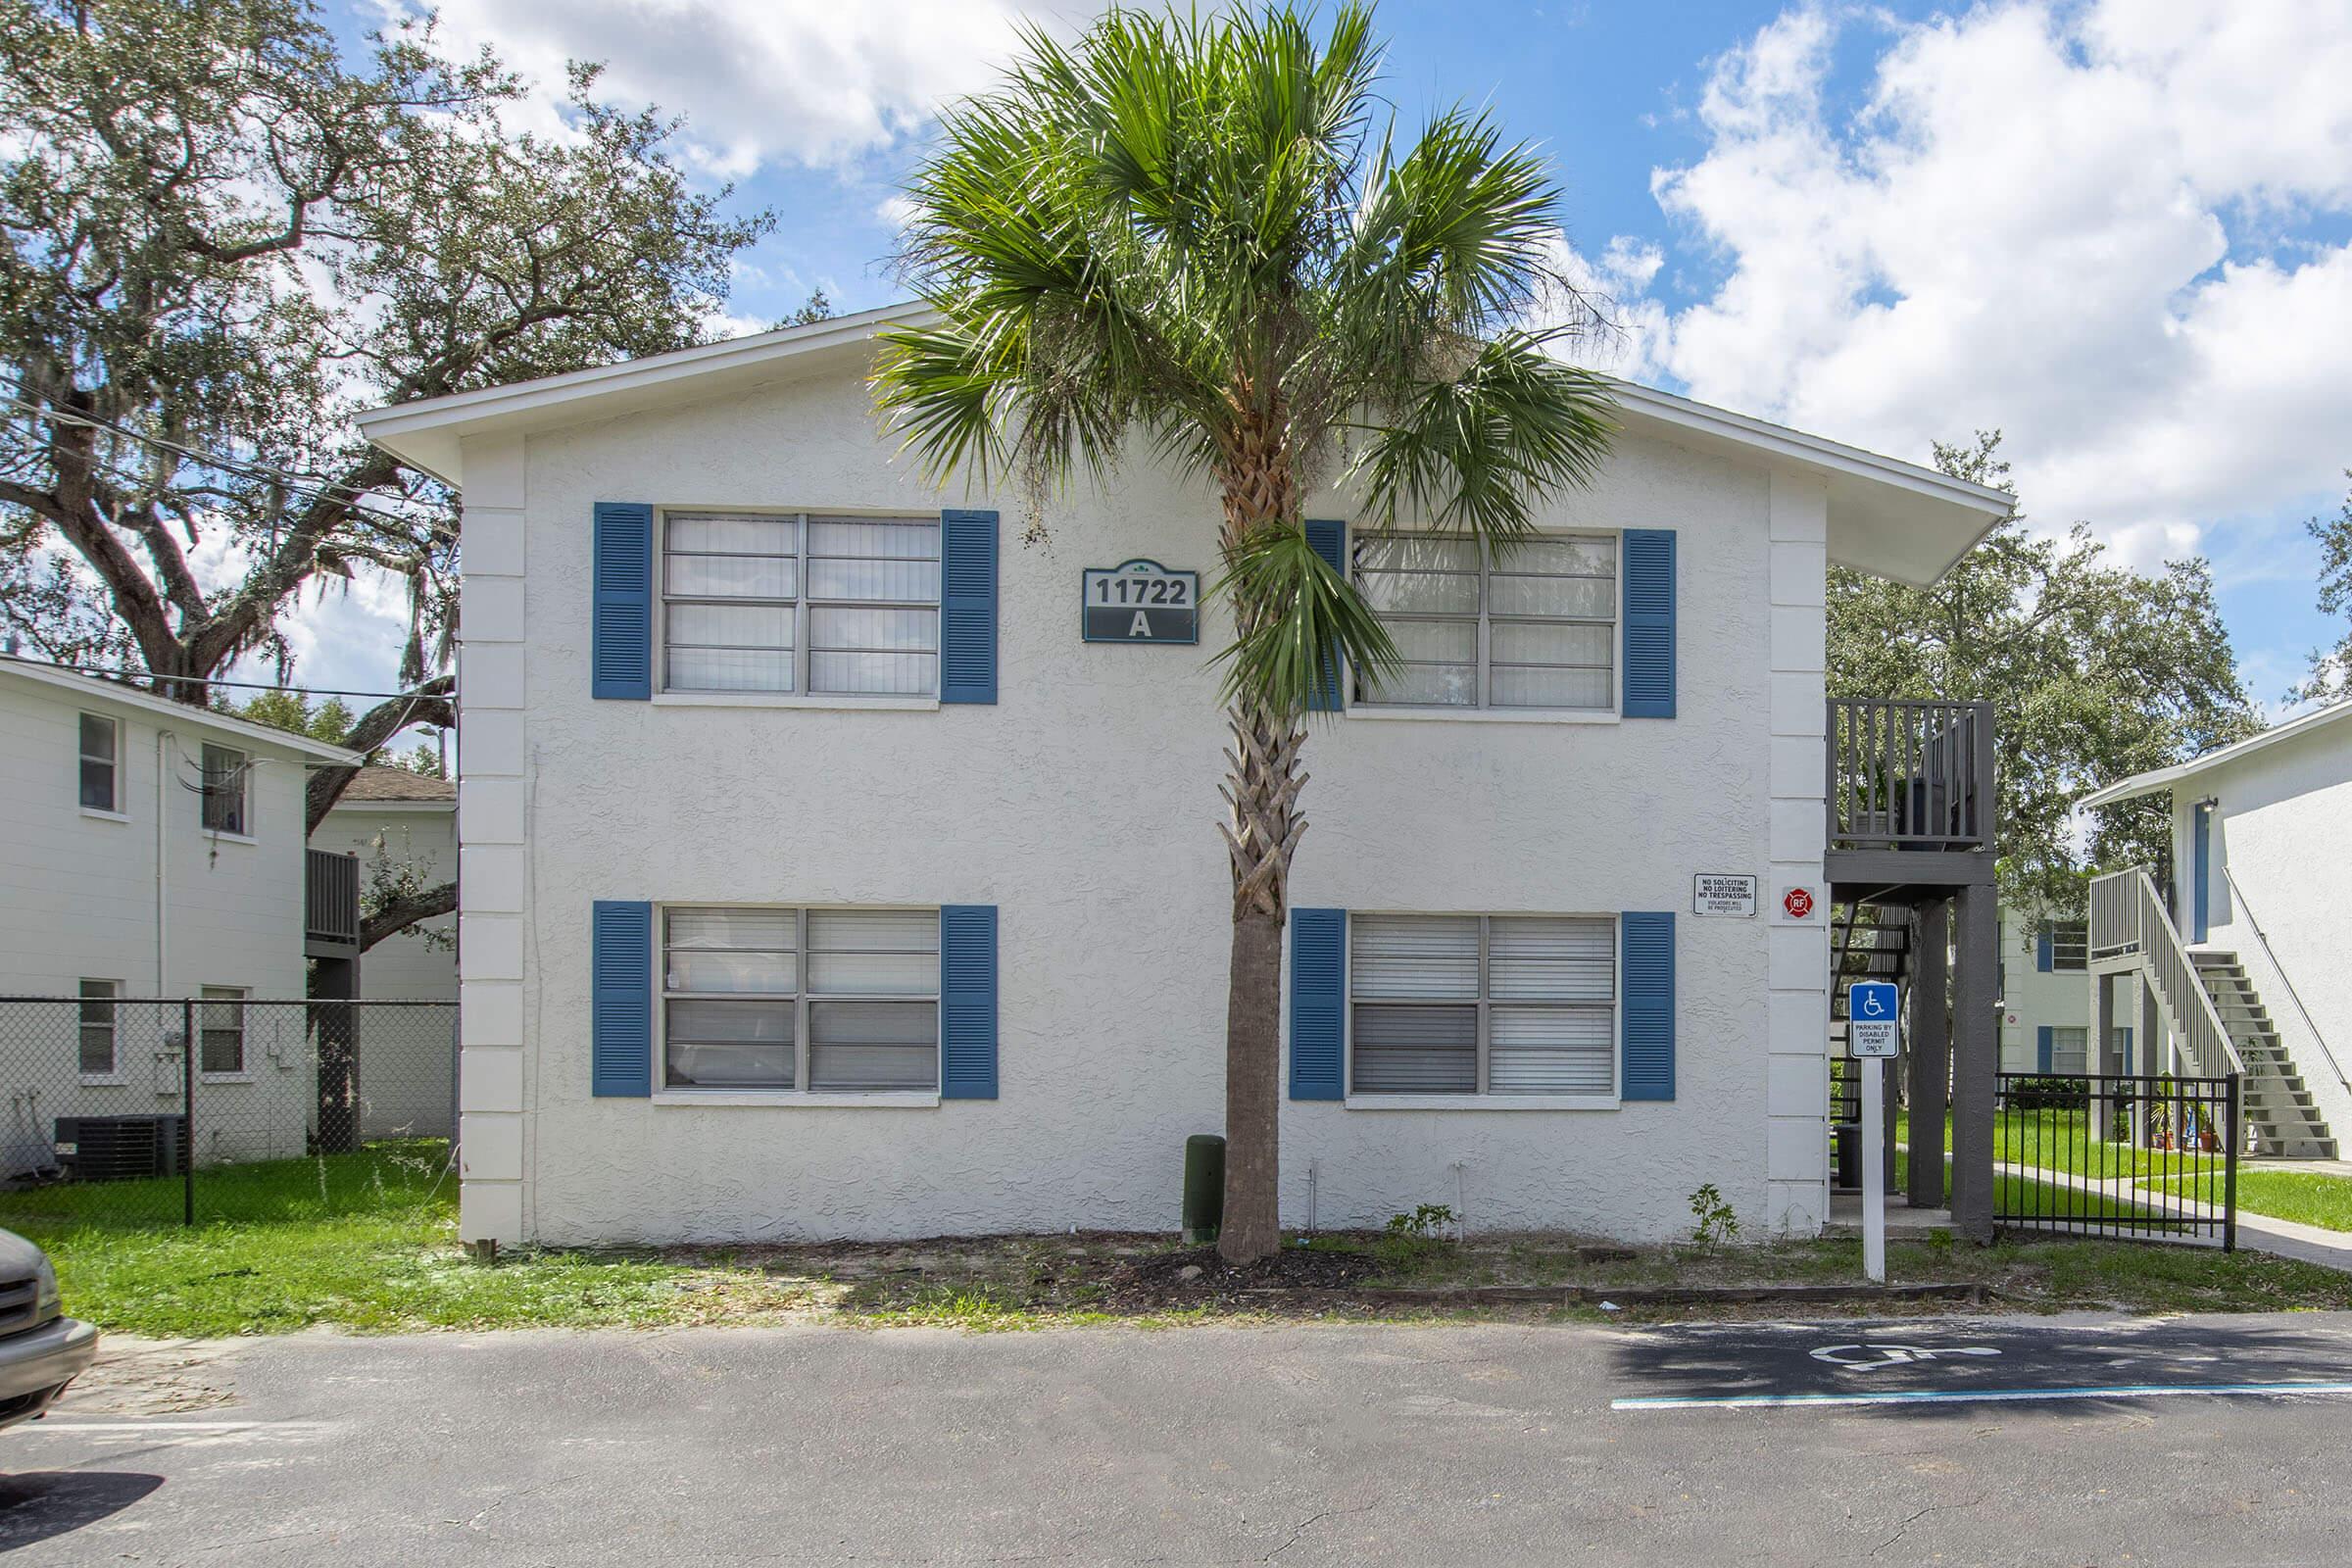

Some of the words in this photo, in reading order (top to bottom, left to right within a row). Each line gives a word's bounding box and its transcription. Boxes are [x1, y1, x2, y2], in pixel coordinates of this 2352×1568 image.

[1096, 578, 1187, 605] 11722
[1128, 611, 1152, 637] A
[1793, 899, 1804, 907] RF
